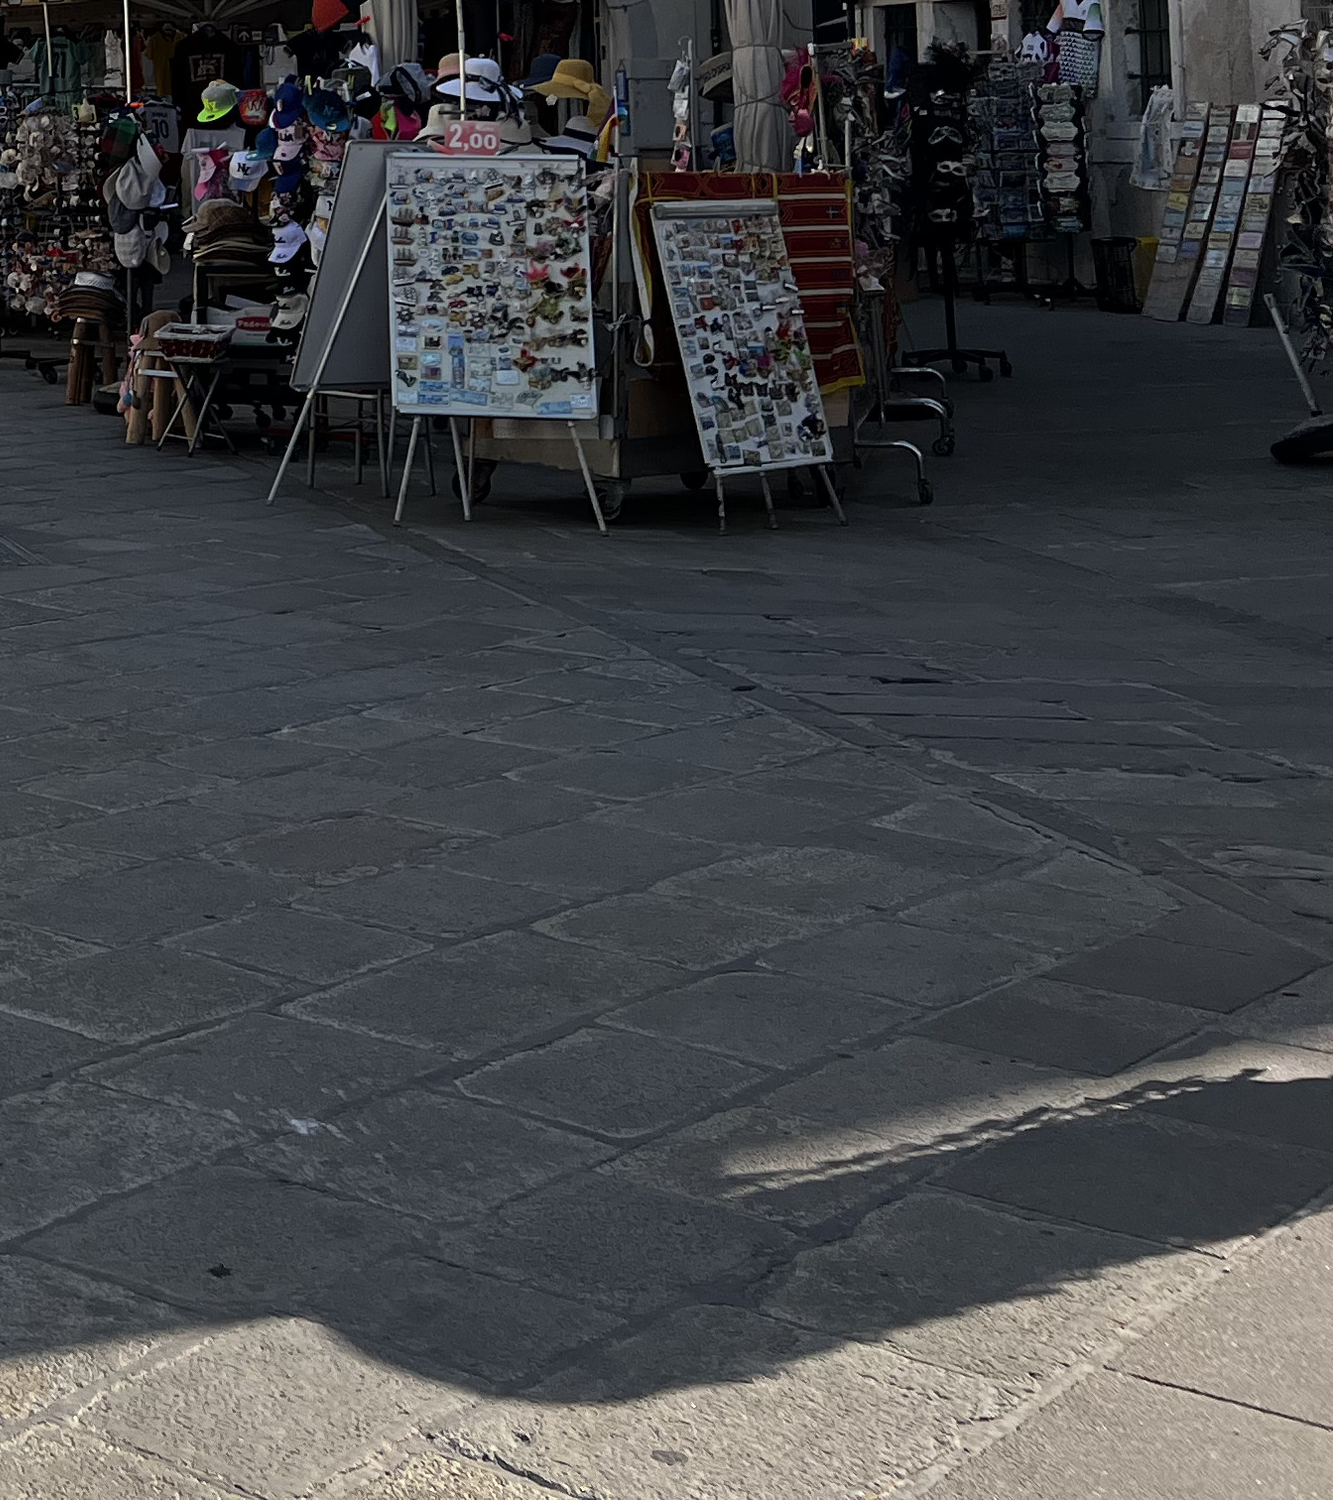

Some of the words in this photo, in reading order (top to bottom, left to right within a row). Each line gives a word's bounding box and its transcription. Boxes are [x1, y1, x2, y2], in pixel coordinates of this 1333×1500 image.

[152, 119, 169, 139] 10
[449, 123, 497, 151] 2,00
[236, 161, 252, 176] NY
